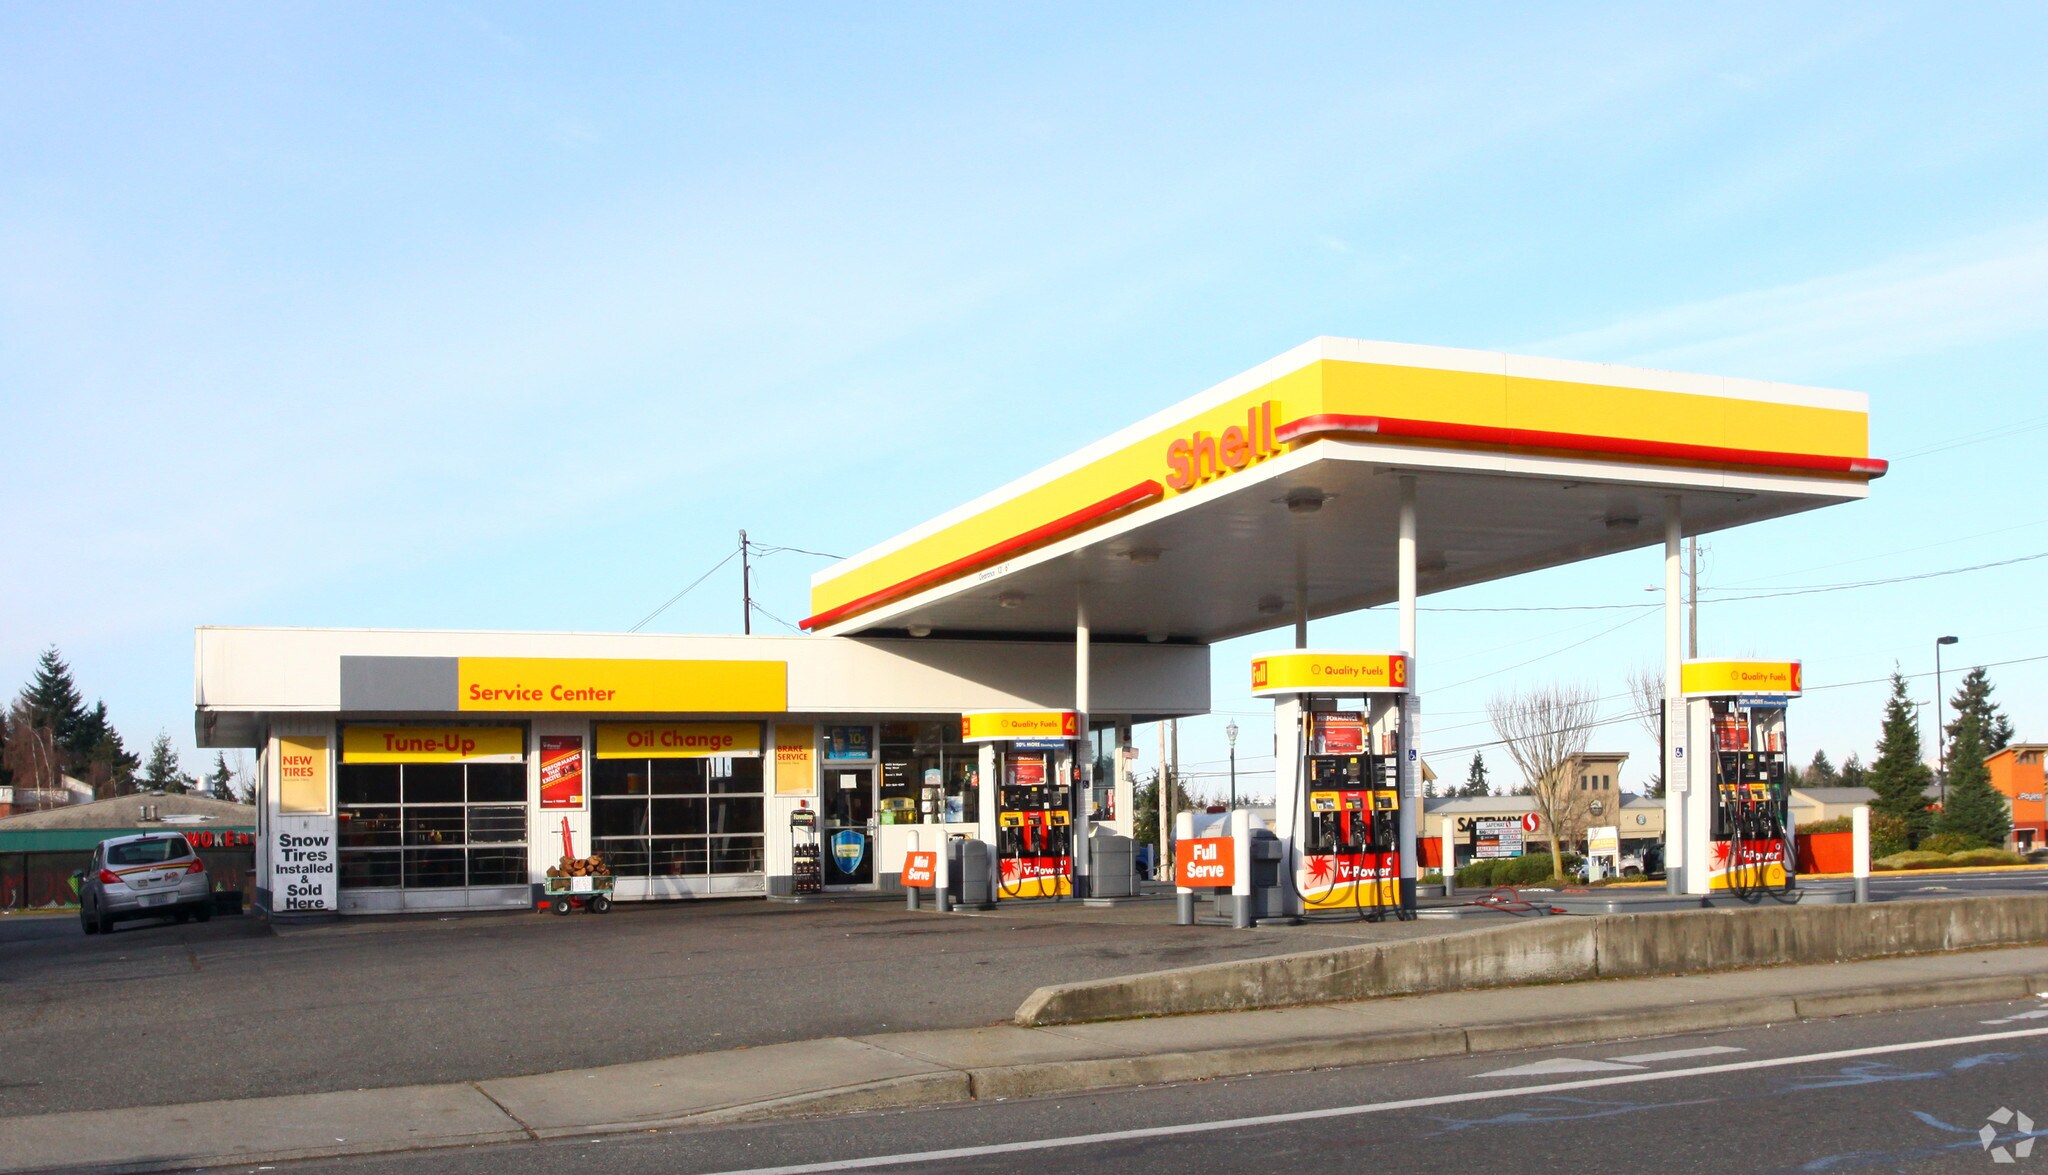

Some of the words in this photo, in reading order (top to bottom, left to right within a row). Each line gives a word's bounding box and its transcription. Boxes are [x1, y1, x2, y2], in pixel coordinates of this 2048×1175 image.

[1165, 400, 1276, 491] Shell
[1325, 665, 1359, 677] Quality
[1362, 666, 1384, 676] Fuels
[1394, 659, 1406, 683] 8
[1741, 672, 1768, 682] Quality
[1769, 673, 1786, 681] Fuels
[469, 683, 543, 701] Service
[550, 684, 616, 701] Center
[1011, 720, 1038, 729] Quality
[1040, 720, 1058, 728] Fuels
[1065, 716, 1077, 732] 4
[383, 733, 476, 756] Tune-Up
[627, 730, 655, 748] Oil
[660, 730, 733, 751] Change
[777, 745, 804, 753] BRAKE
[283, 756, 313, 766] NEW
[541, 753, 581, 773] PERFORMANCE
[777, 753, 808, 761] SERVICE
[283, 767, 314, 777] TIRES
[547, 767, 561, 777] THAT
[182, 830, 235, 847] MOKE
[279, 833, 329, 847] Snow
[281, 849, 328, 862] Tires
[1193, 843, 1217, 860] Full
[913, 855, 929, 868] Mini
[275, 863, 333, 875] Installed
[908, 867, 930, 880] Serve
[1023, 866, 1064, 875] V-Power
[1187, 861, 1224, 878] Serve
[1340, 865, 1391, 878] V-Power
[300, 875, 309, 884] &
[287, 884, 322, 897] Sold
[286, 898, 325, 910] Here
